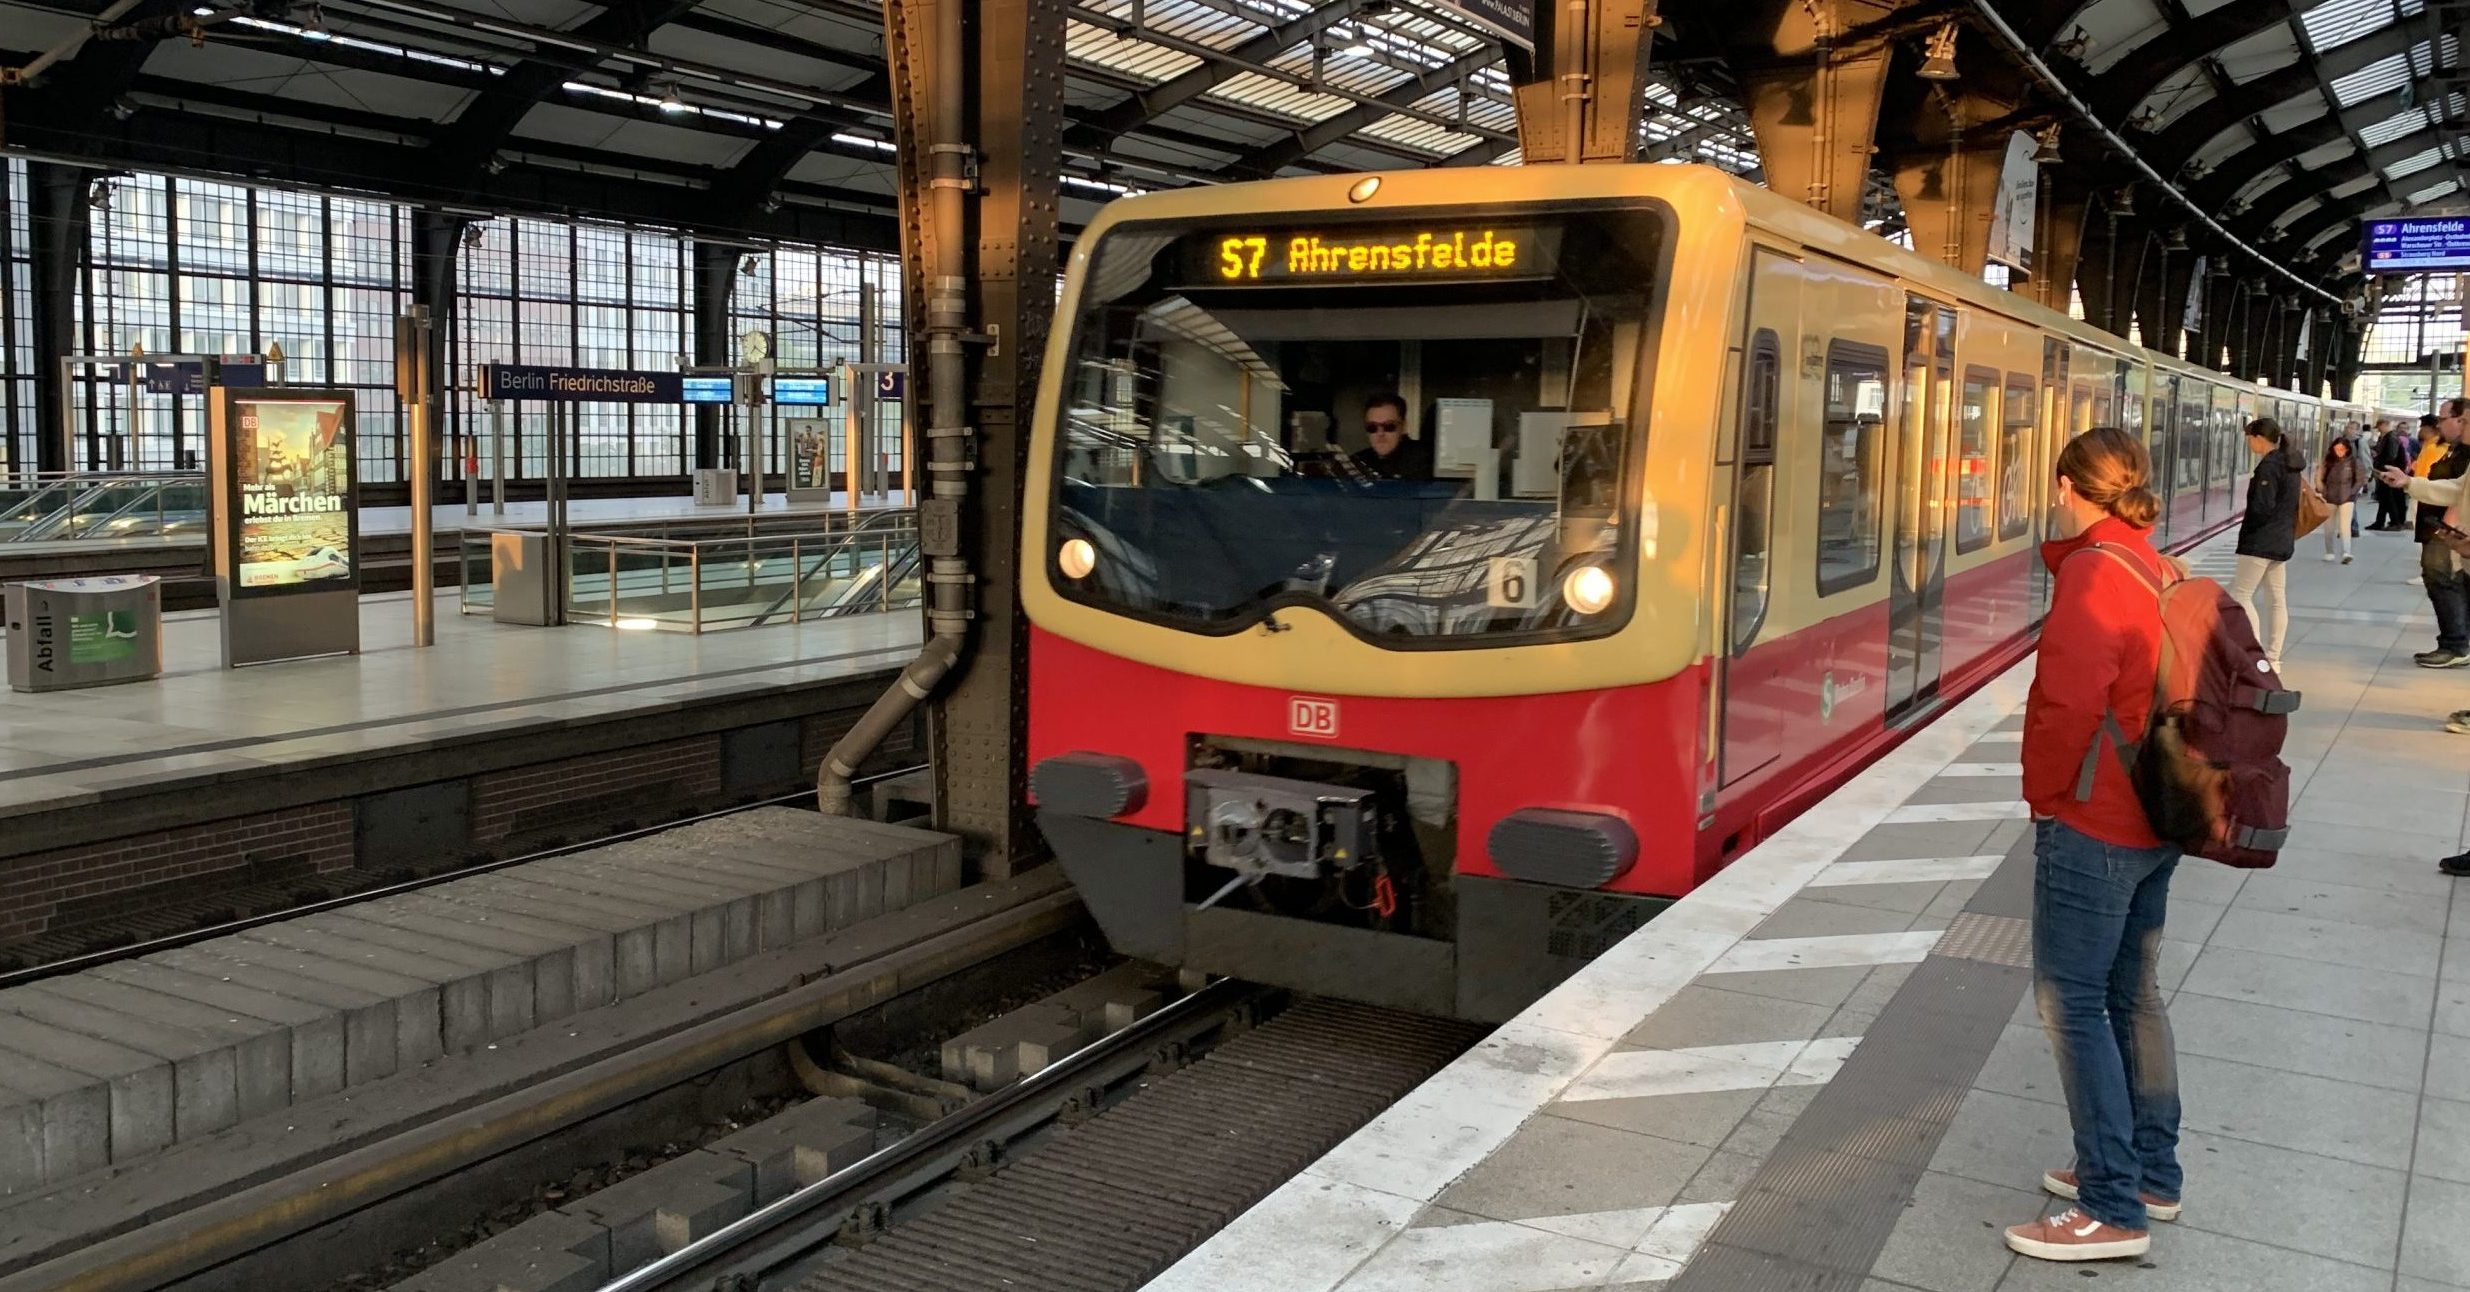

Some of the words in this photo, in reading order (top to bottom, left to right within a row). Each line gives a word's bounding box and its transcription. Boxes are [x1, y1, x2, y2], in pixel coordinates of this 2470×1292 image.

[2378, 224, 2393, 234] S7
[2401, 221, 2464, 234] Ahrensfelde
[1221, 238, 1267, 279] S7
[1288, 231, 1517, 273] Ahrensfelde
[501, 371, 544, 390] Berlin
[549, 373, 656, 393] Friedrichstraße
[880, 372, 894, 391] 3
[244, 492, 341, 514] Märchen
[1504, 560, 1525, 603] 6
[36, 616, 53, 673] Abfall
[1294, 701, 1333, 732] DB
